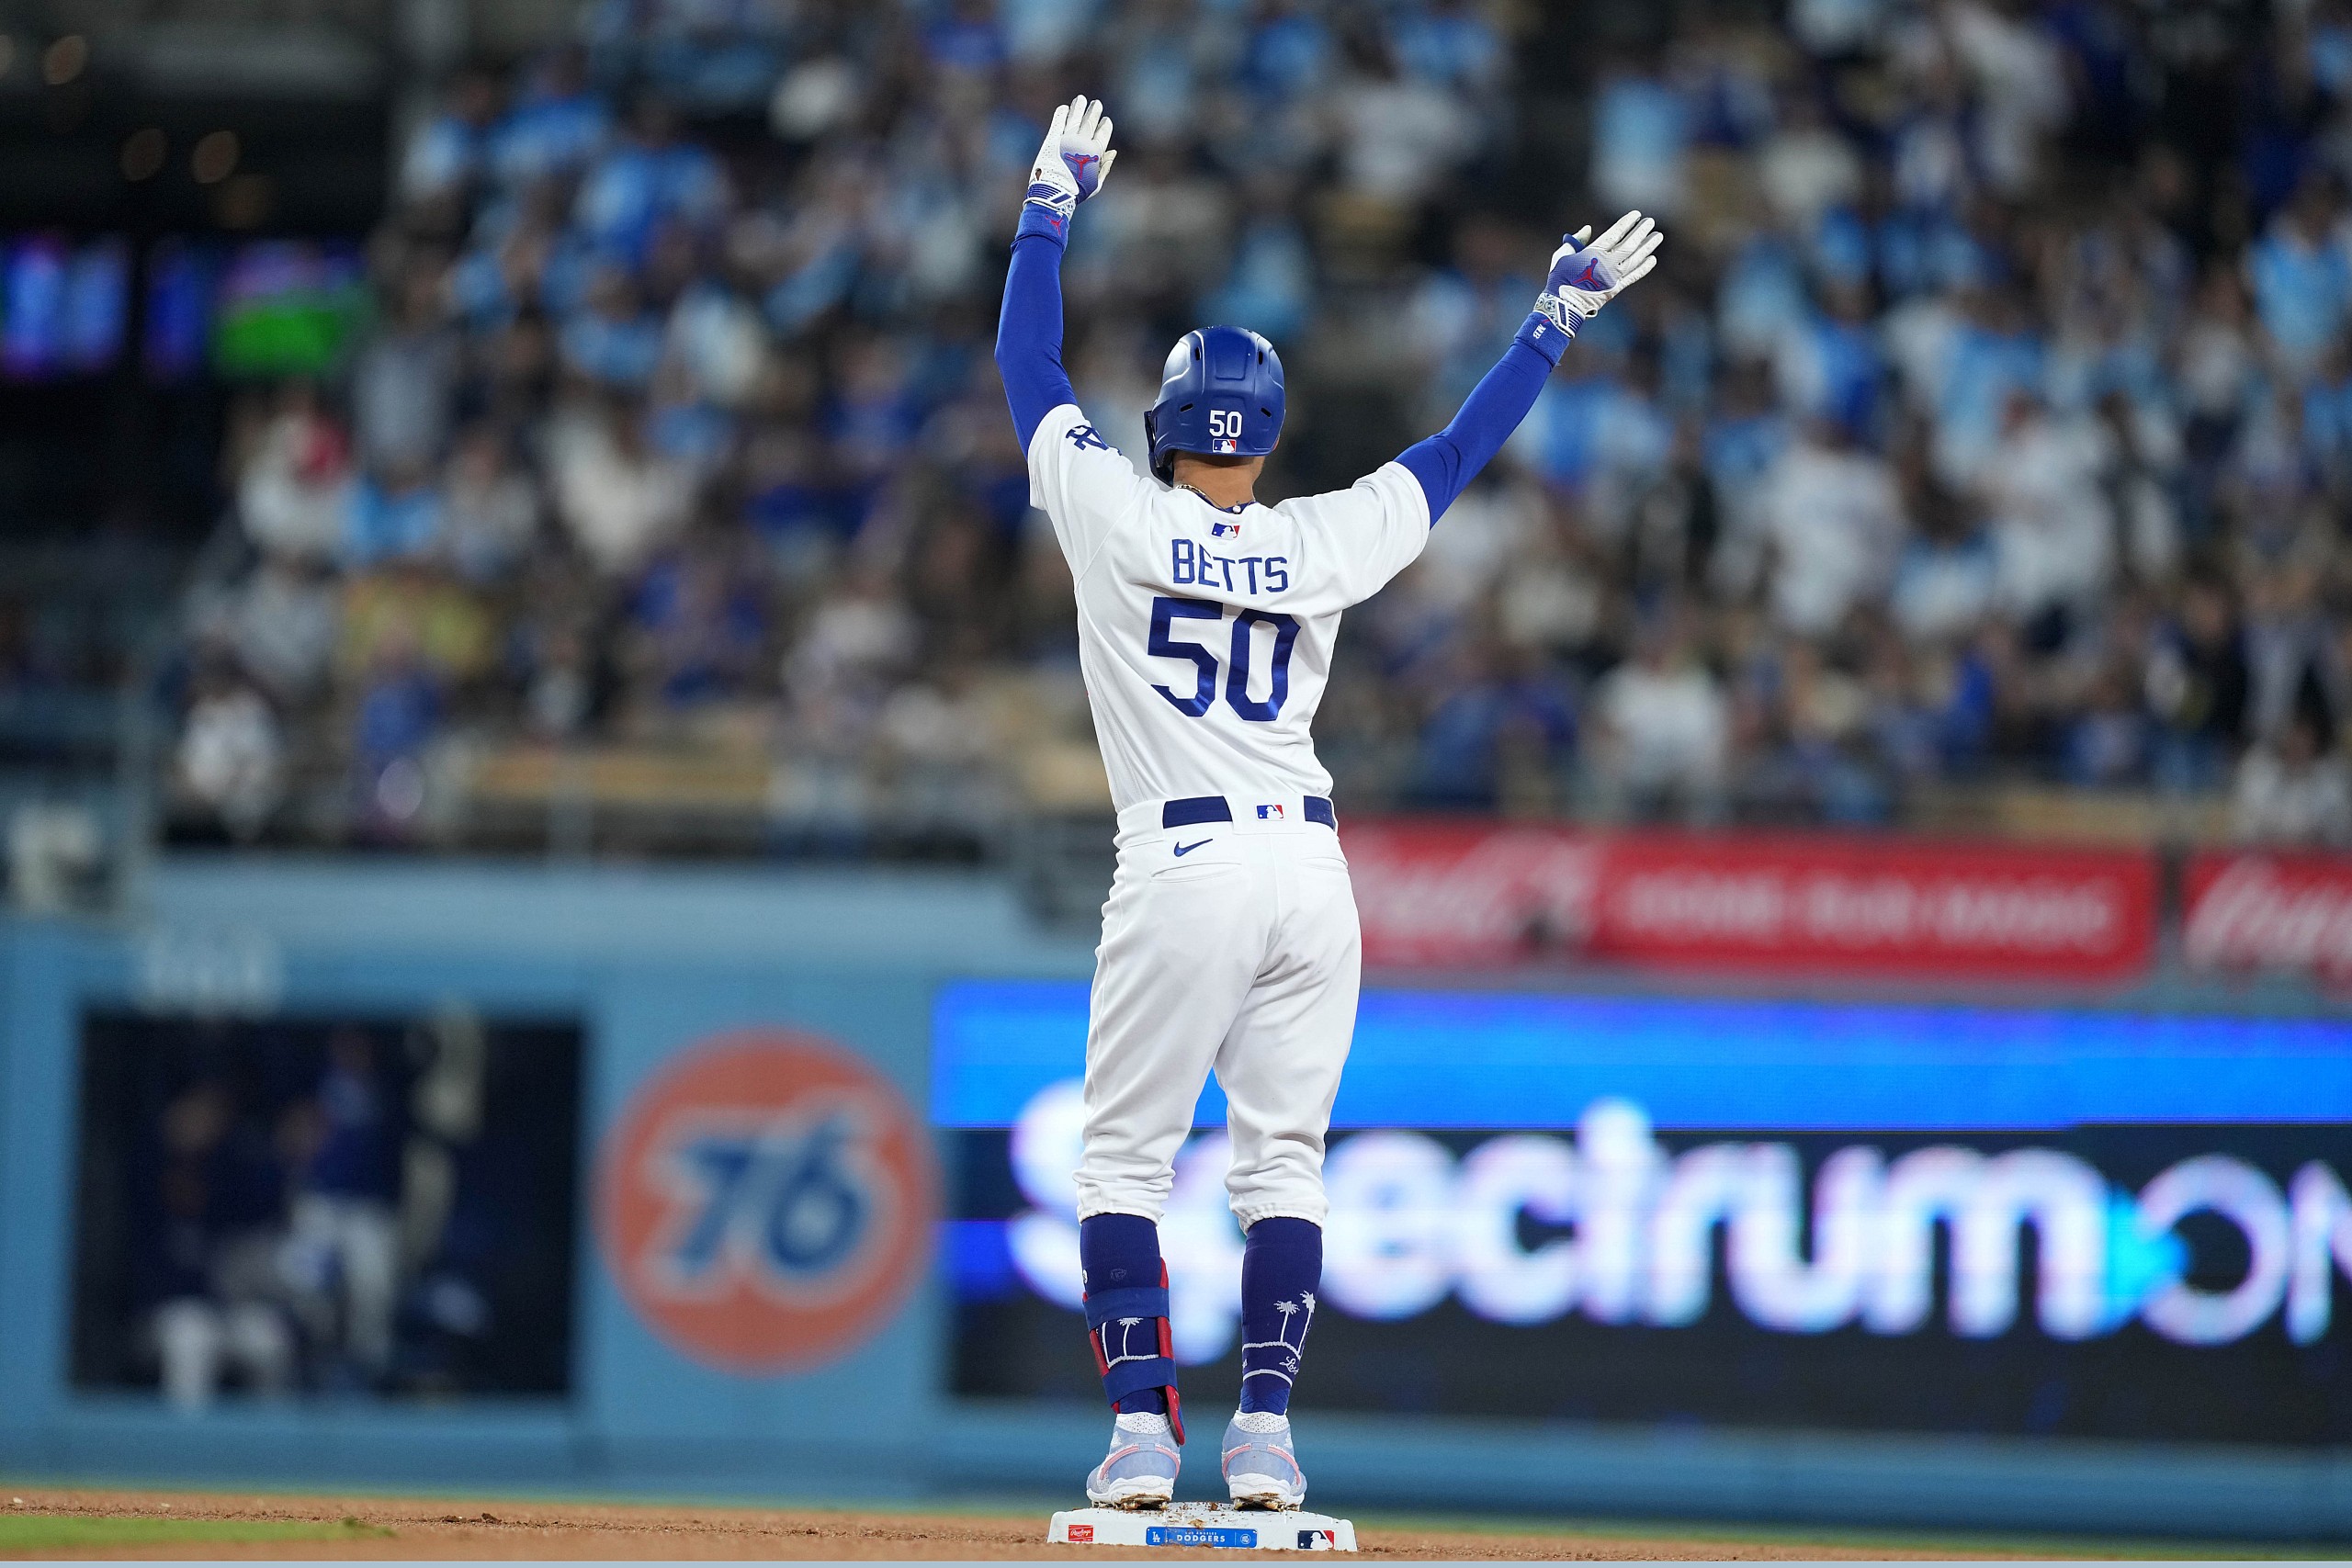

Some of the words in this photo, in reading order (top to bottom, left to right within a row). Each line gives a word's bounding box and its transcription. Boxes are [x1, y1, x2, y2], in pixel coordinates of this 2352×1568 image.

[1208, 410, 1242, 437] 50
[1171, 538, 1288, 595] BETTS
[1148, 596, 1301, 722] 50
[660, 1104, 884, 1288] 76
[1176, 1535, 1226, 1543] DODGERS
